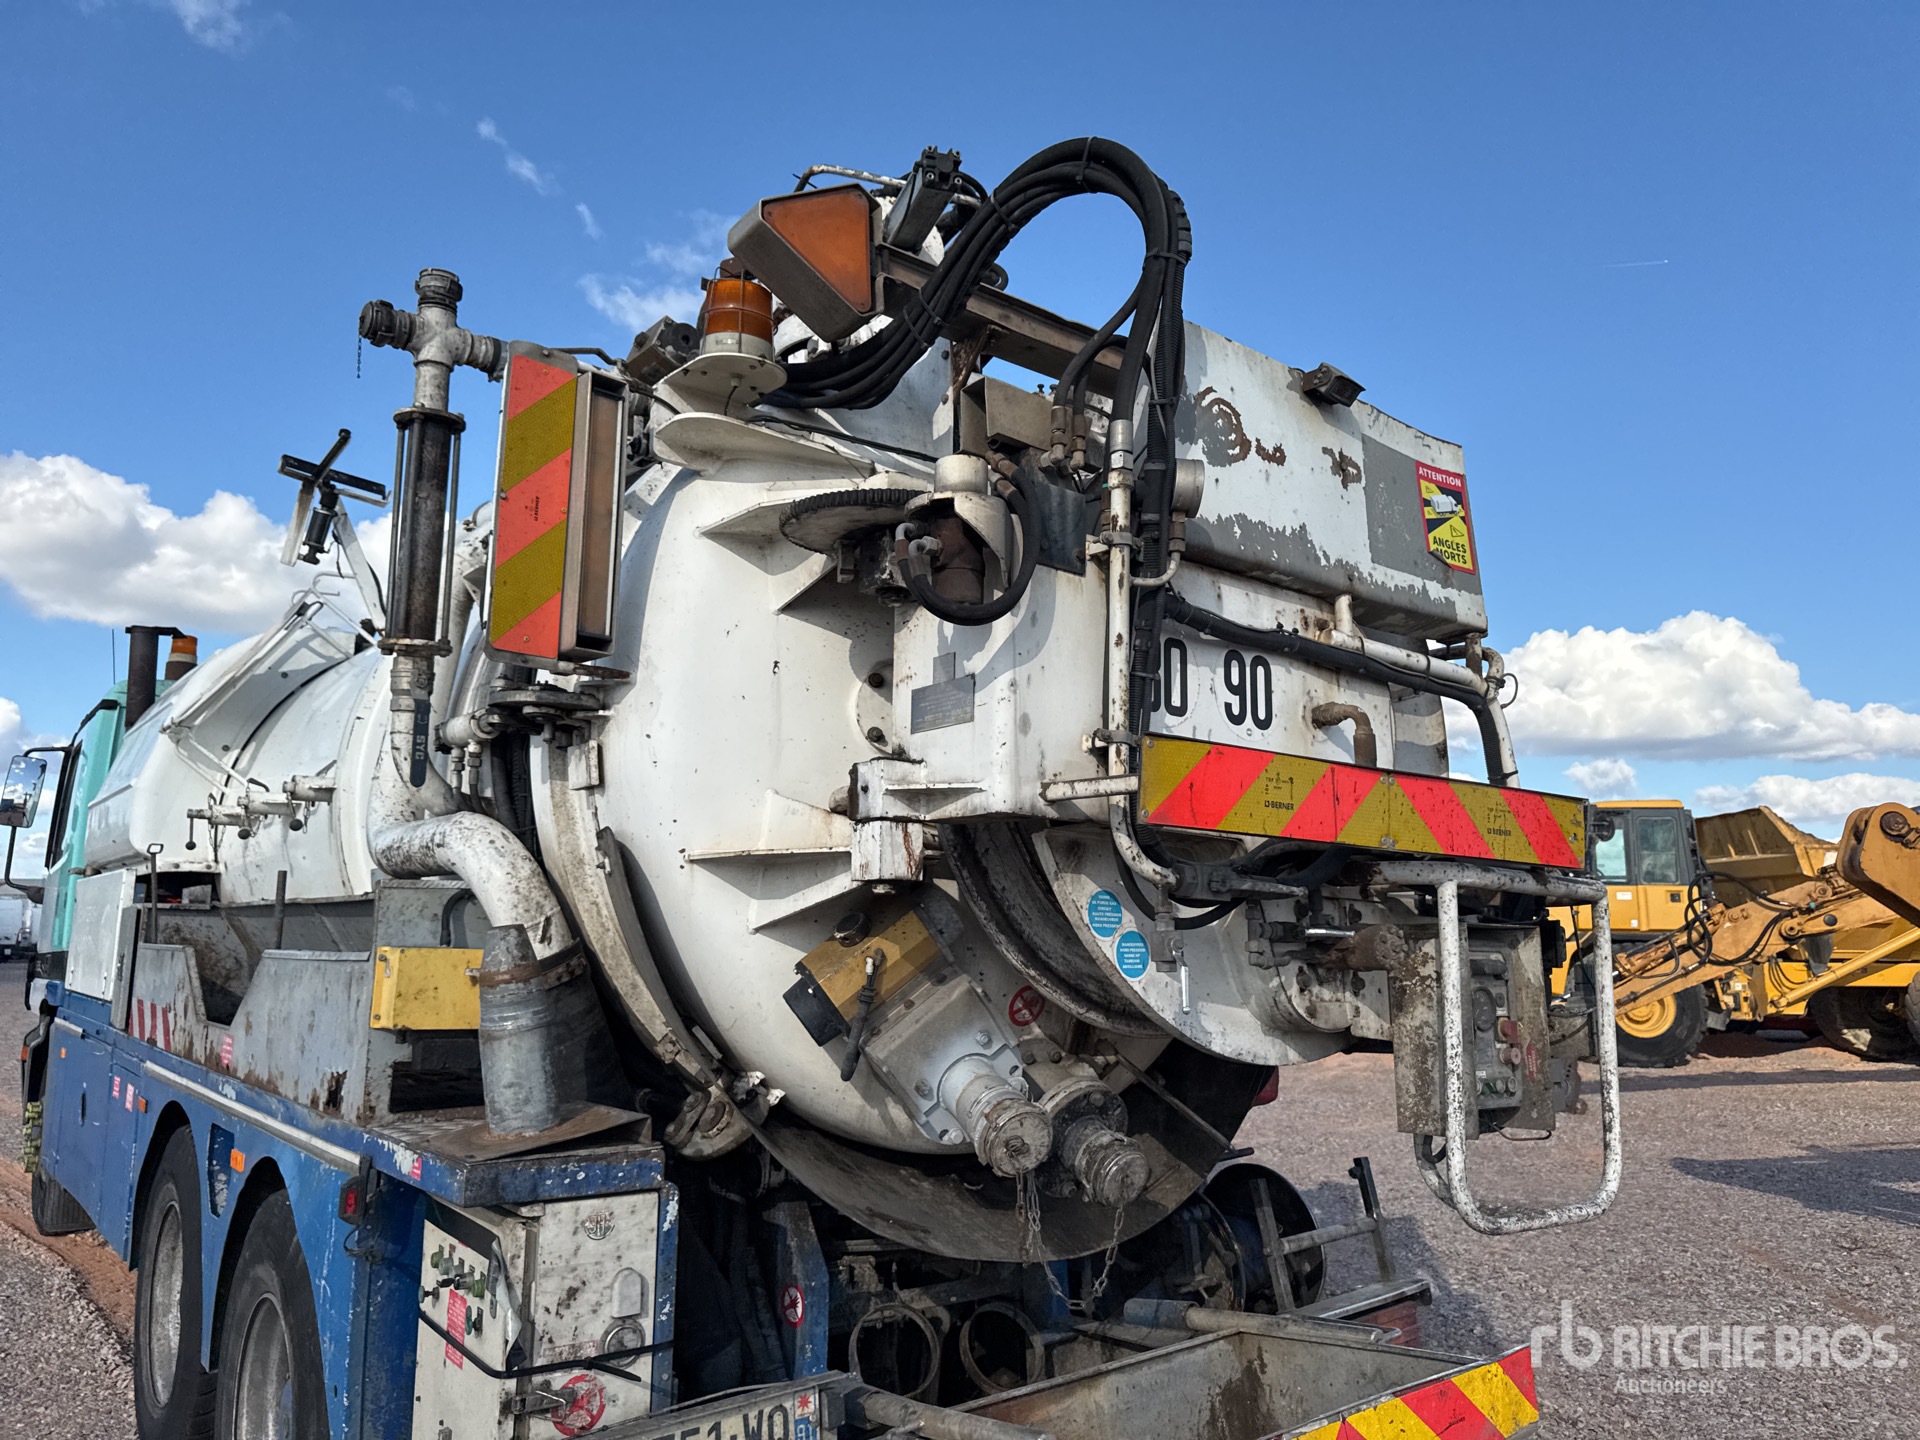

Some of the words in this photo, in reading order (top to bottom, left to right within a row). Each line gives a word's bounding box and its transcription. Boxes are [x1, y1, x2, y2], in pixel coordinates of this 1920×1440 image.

[1418, 466, 1462, 487] ATTENTION
[1433, 535, 1467, 554] ANGLES
[1151, 636, 1188, 718] 0
[1224, 649, 1273, 731] 90
[415, 735, 426, 760] SYC
